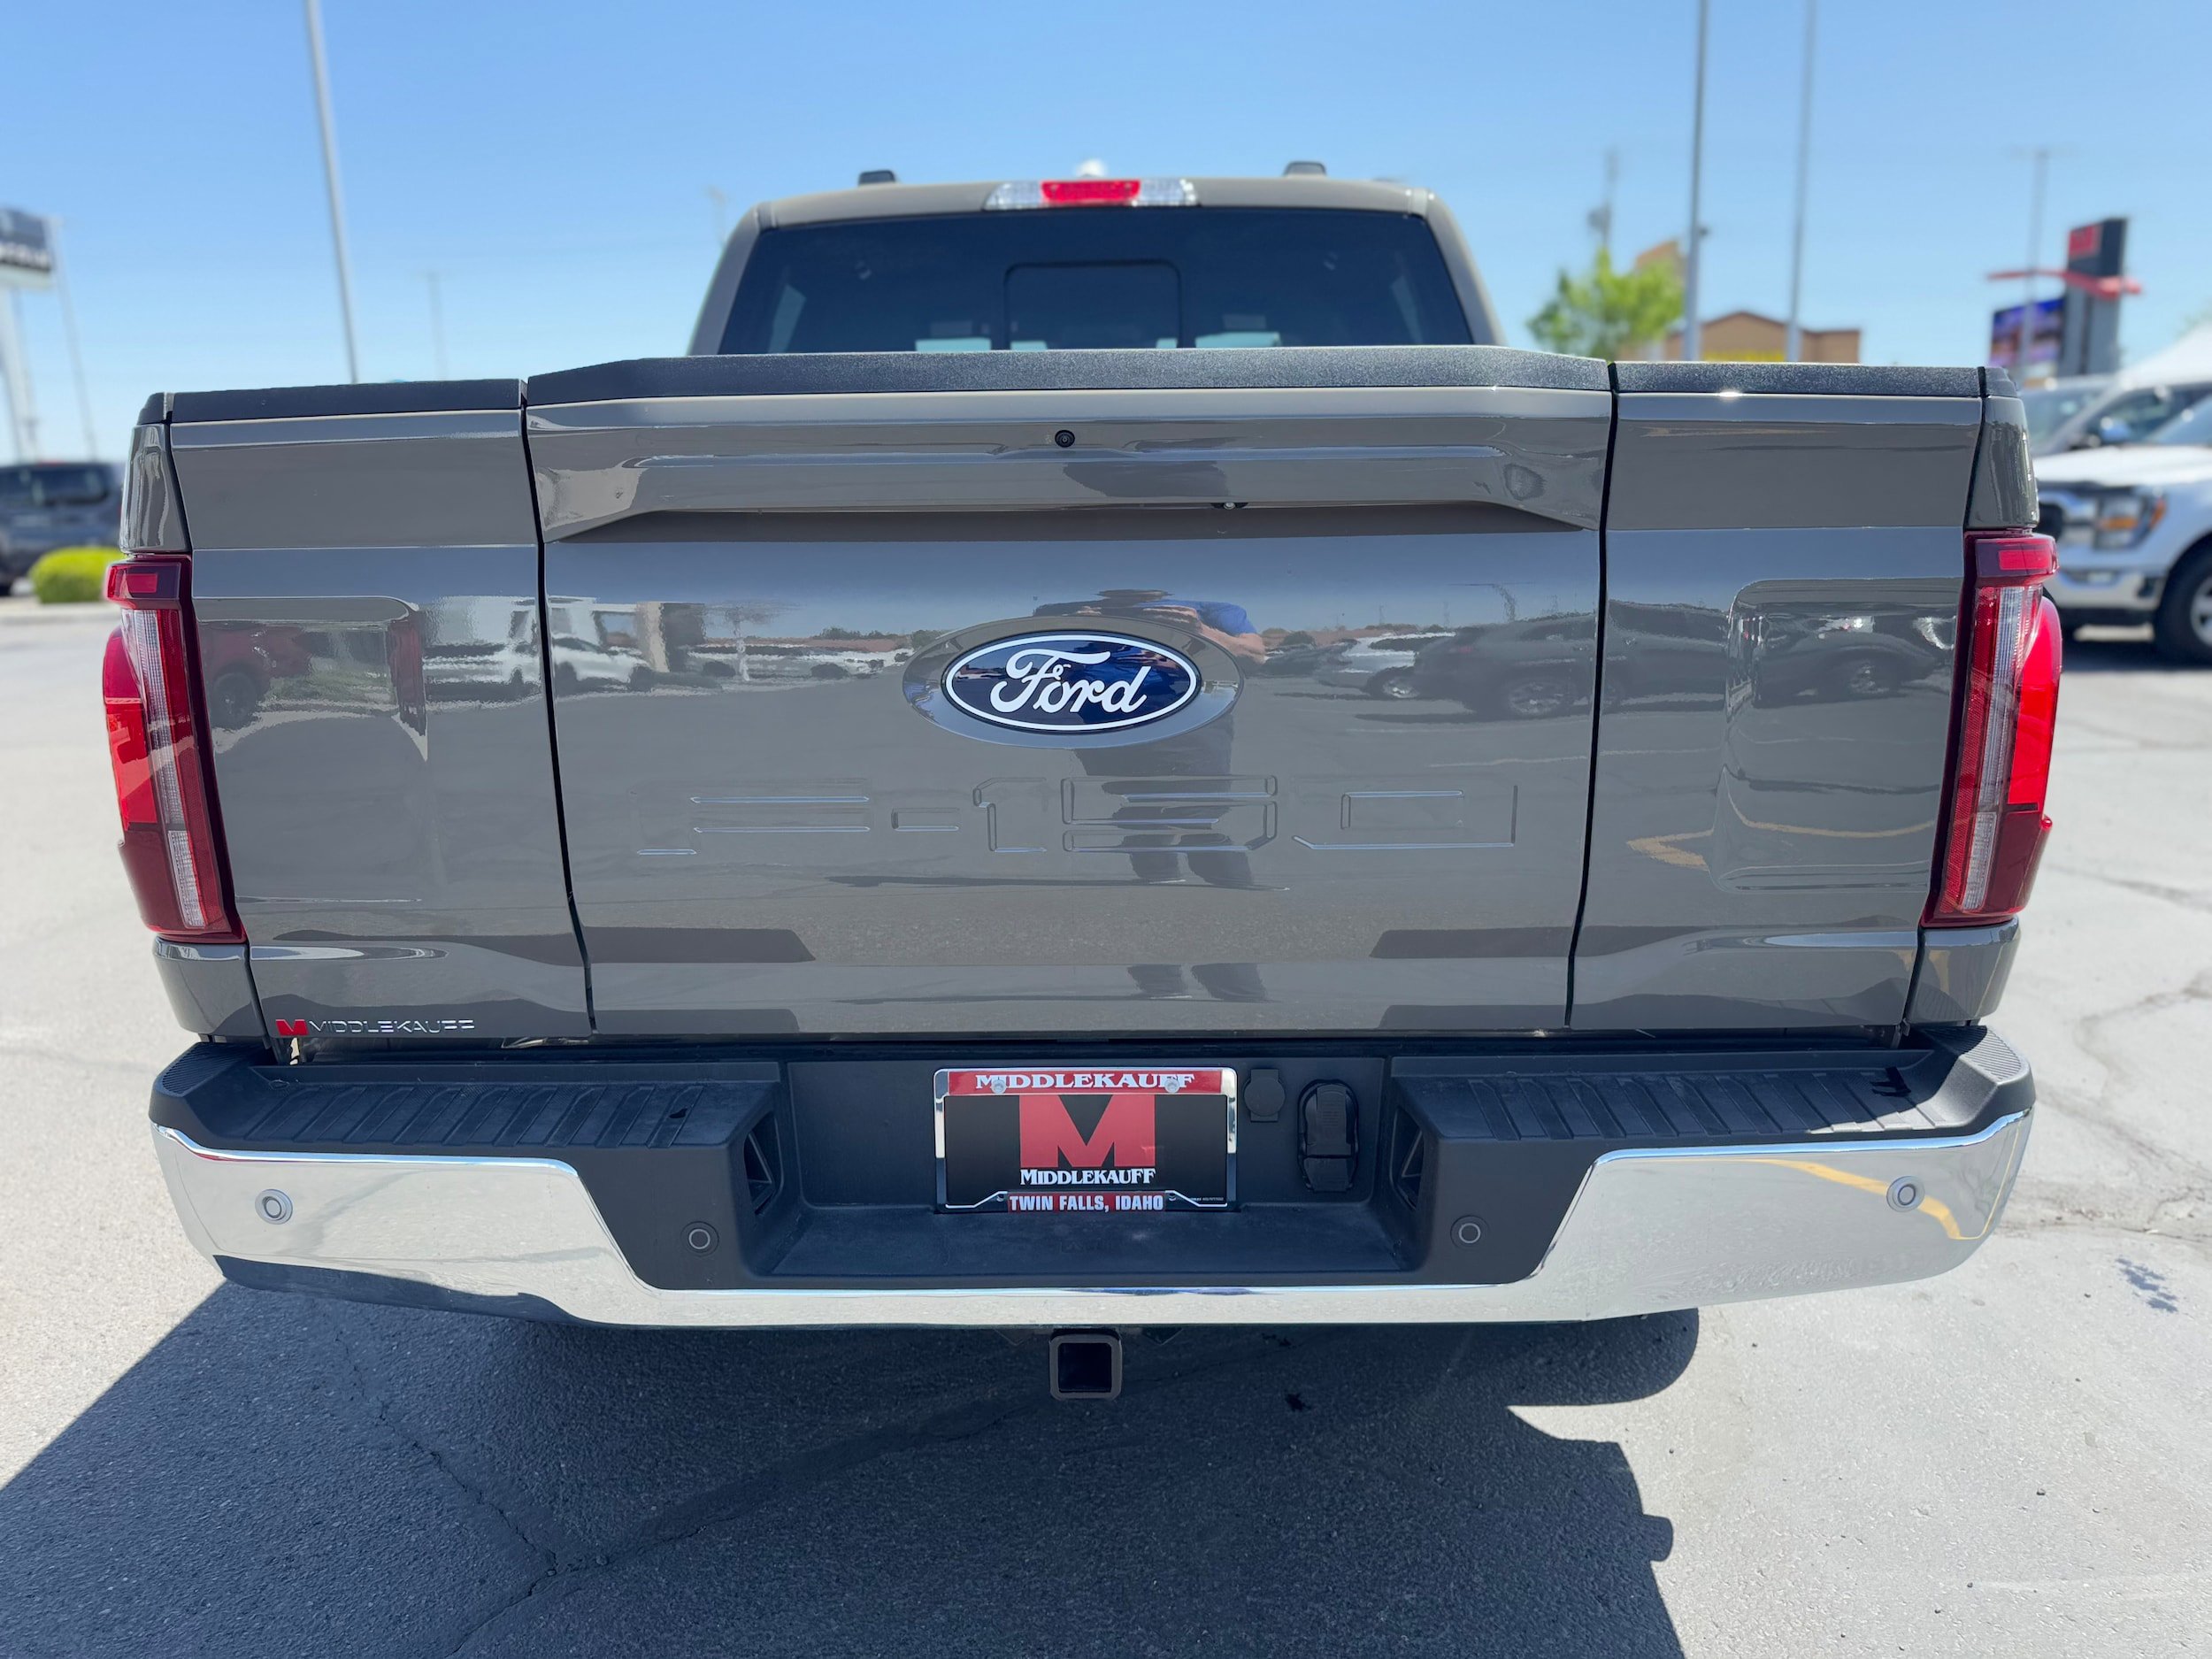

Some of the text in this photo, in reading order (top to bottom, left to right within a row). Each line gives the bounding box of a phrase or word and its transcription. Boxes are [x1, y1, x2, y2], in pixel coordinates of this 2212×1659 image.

[989, 649, 1151, 713] Ford
[628, 775, 1519, 852] F-150
[1020, 1168, 1156, 1187] MIDDLEKAUFF
[1010, 1195, 1164, 1213] TWIN FALLS, IDAHO
